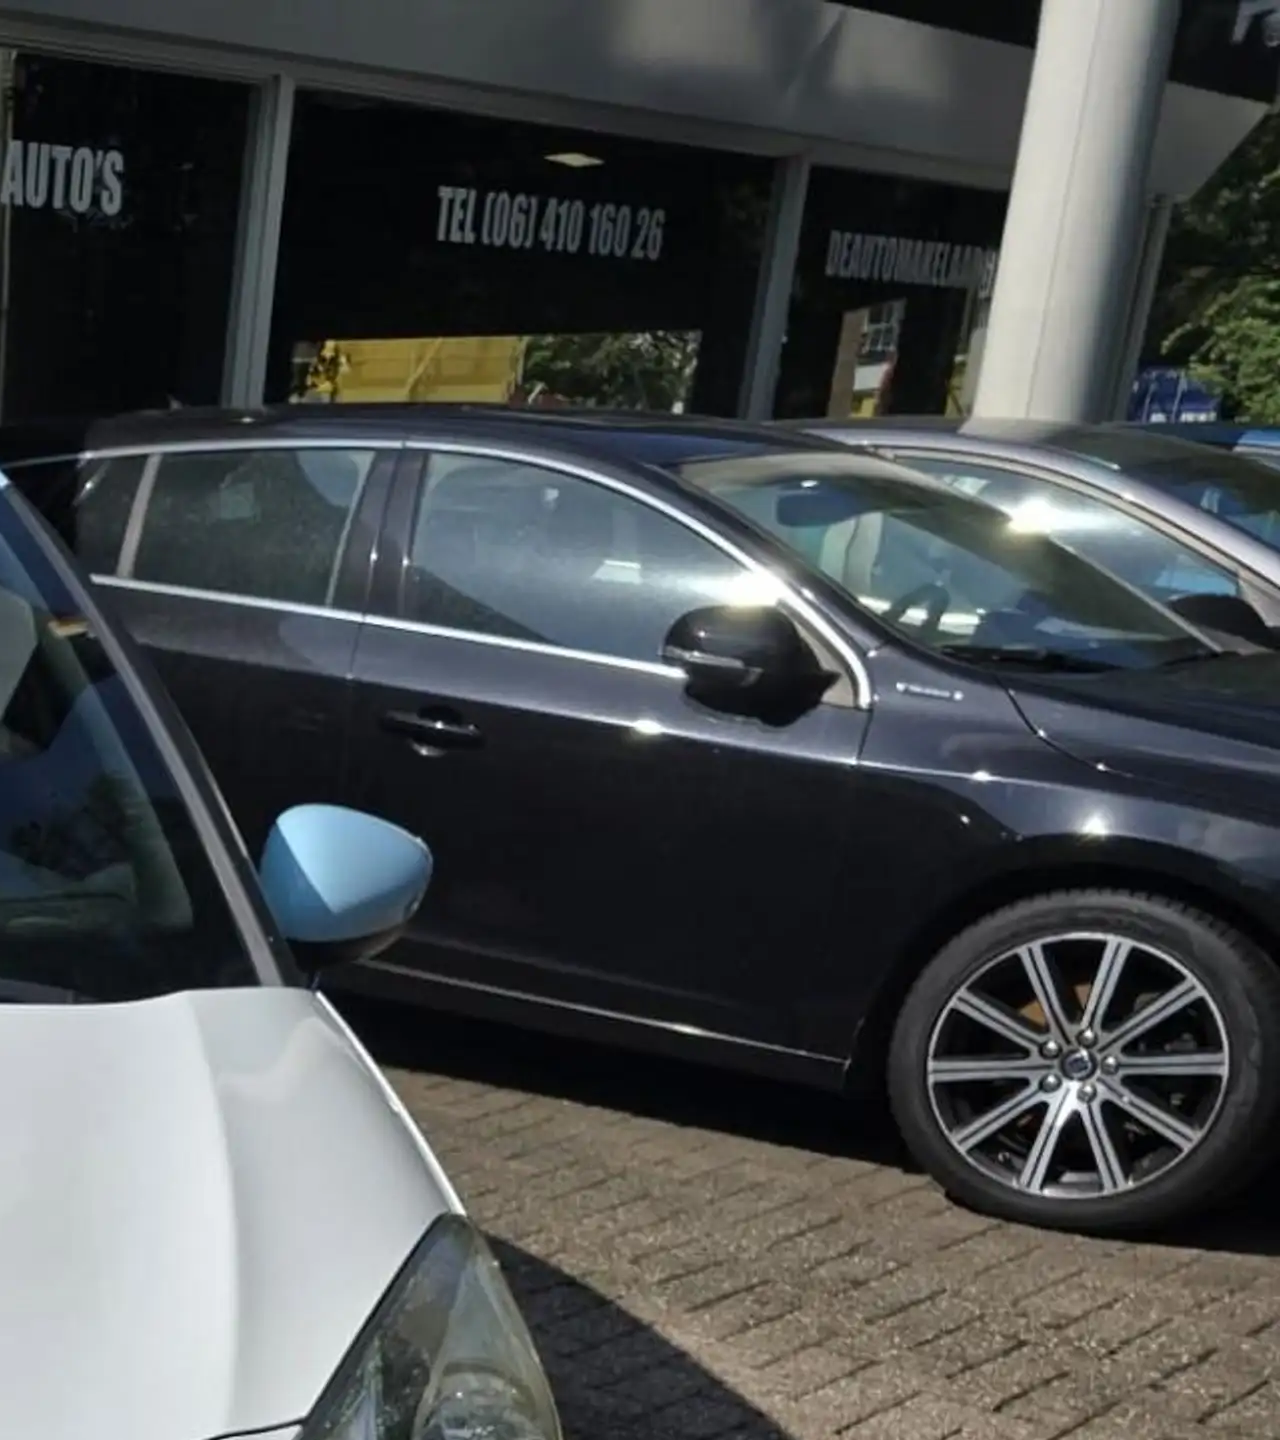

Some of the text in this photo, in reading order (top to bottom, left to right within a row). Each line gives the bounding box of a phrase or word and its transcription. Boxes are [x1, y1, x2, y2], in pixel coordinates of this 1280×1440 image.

[0, 139, 124, 216] AUTO'S
[437, 186, 665, 260] TEL (06) 410 160 26
